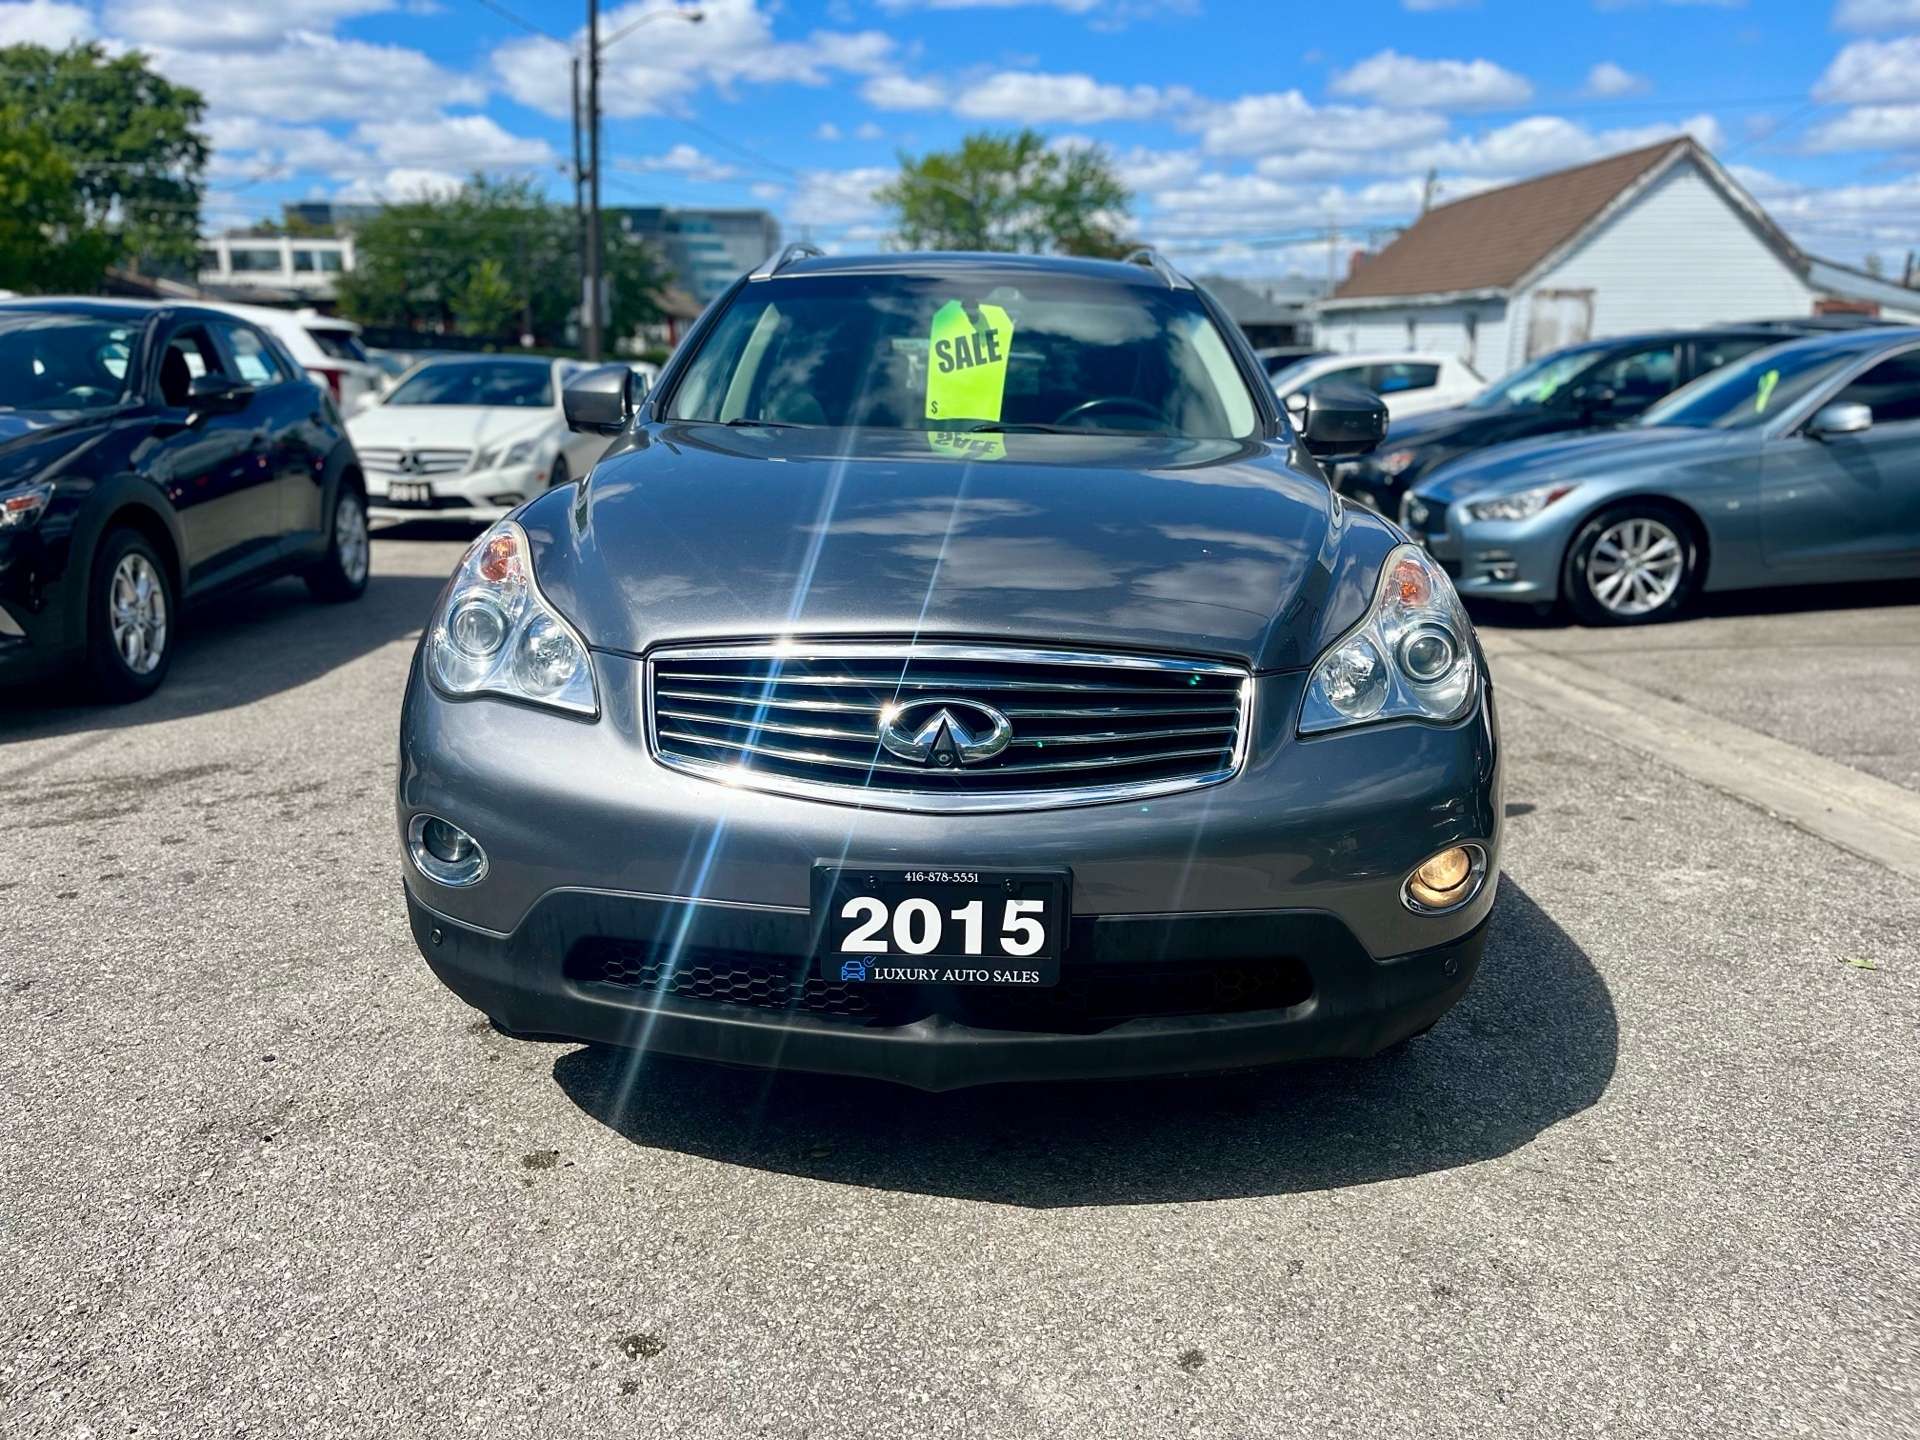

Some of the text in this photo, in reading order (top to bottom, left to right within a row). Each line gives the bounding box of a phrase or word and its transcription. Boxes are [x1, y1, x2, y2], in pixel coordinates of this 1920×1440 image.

[935, 328, 1003, 374] SALE
[931, 400, 939, 415] $
[904, 871, 979, 883] 416-878-5551
[840, 896, 1045, 956] 2015
[874, 967, 1040, 984] LUXURY AUTO SALES
